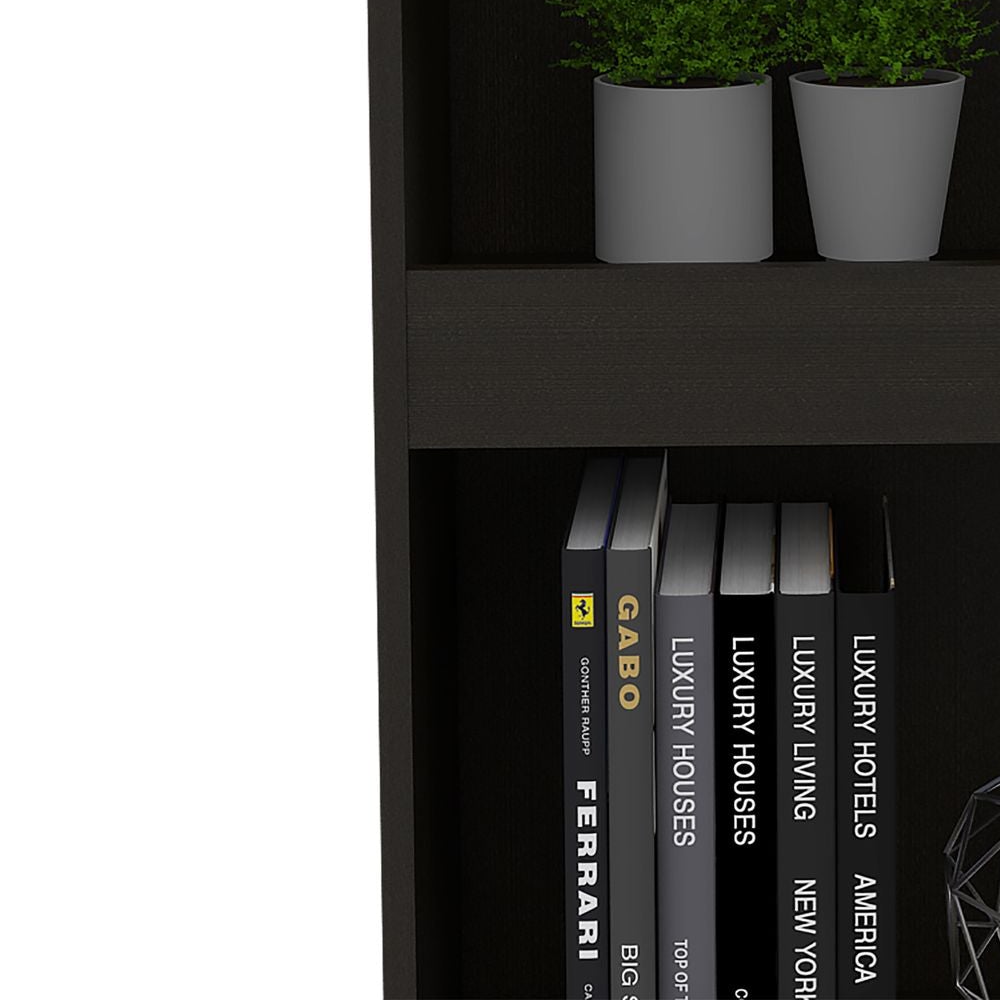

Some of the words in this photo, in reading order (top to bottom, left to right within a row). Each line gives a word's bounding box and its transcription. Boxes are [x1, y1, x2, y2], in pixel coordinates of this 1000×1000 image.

[618, 594, 641, 710] GABO
[671, 637, 695, 736] LUXURY
[732, 637, 756, 735] LUXURY
[792, 636, 816, 734] LUXURY
[853, 635, 877, 734] LUXURY
[581, 716, 591, 756] RAUPP
[793, 742, 817, 820] LIVING
[672, 744, 696, 847] HOUSES
[732, 743, 756, 846] HOUSES
[853, 742, 877, 839] HOTELS
[576, 780, 599, 960] FERRARI
[794, 879, 817, 935] NEW
[621, 944, 639, 986] BIG
[674, 938, 689, 969] TOP
[854, 873, 877, 984] AMERICA
[674, 971, 689, 993] OF
